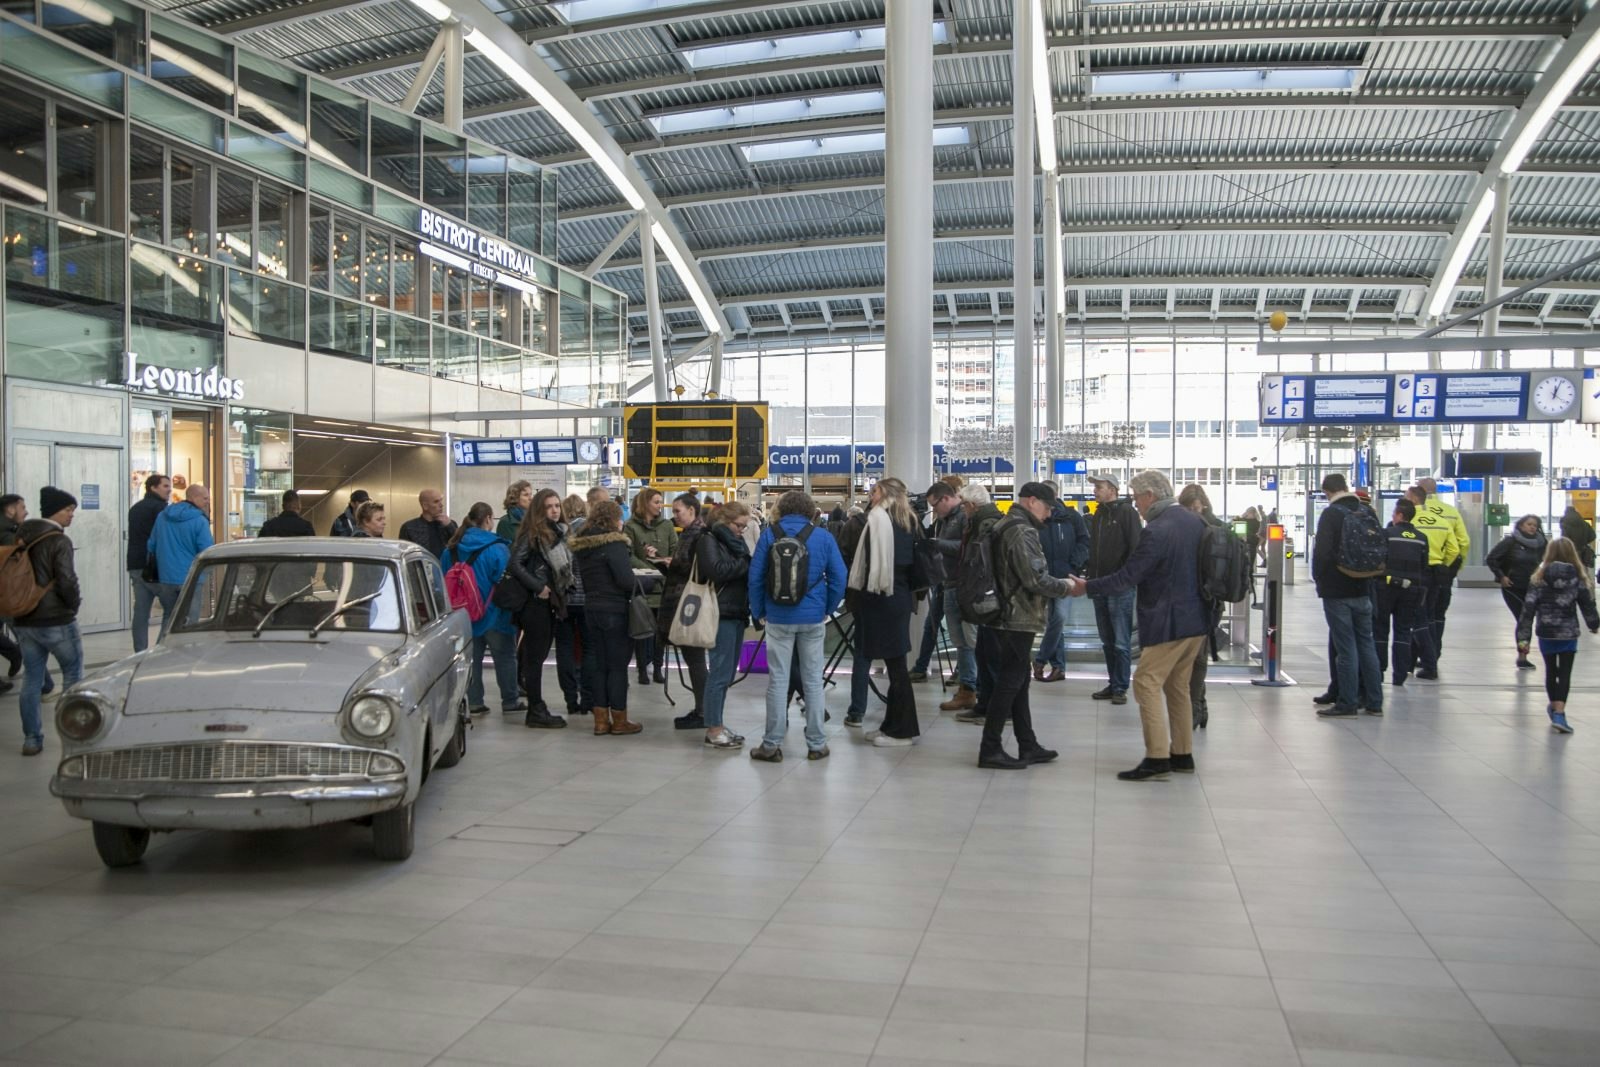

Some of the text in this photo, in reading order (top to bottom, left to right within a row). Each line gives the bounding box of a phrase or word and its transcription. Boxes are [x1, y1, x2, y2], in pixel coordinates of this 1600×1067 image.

[421, 209, 536, 277] BISTROT CENTRAAL
[125, 352, 245, 400] Leonidas
[1292, 386, 1297, 396] 1
[1422, 384, 1430, 395] 3
[1291, 407, 1298, 417] 2
[613, 448, 621, 465] 1
[769, 451, 841, 465] Centrum
